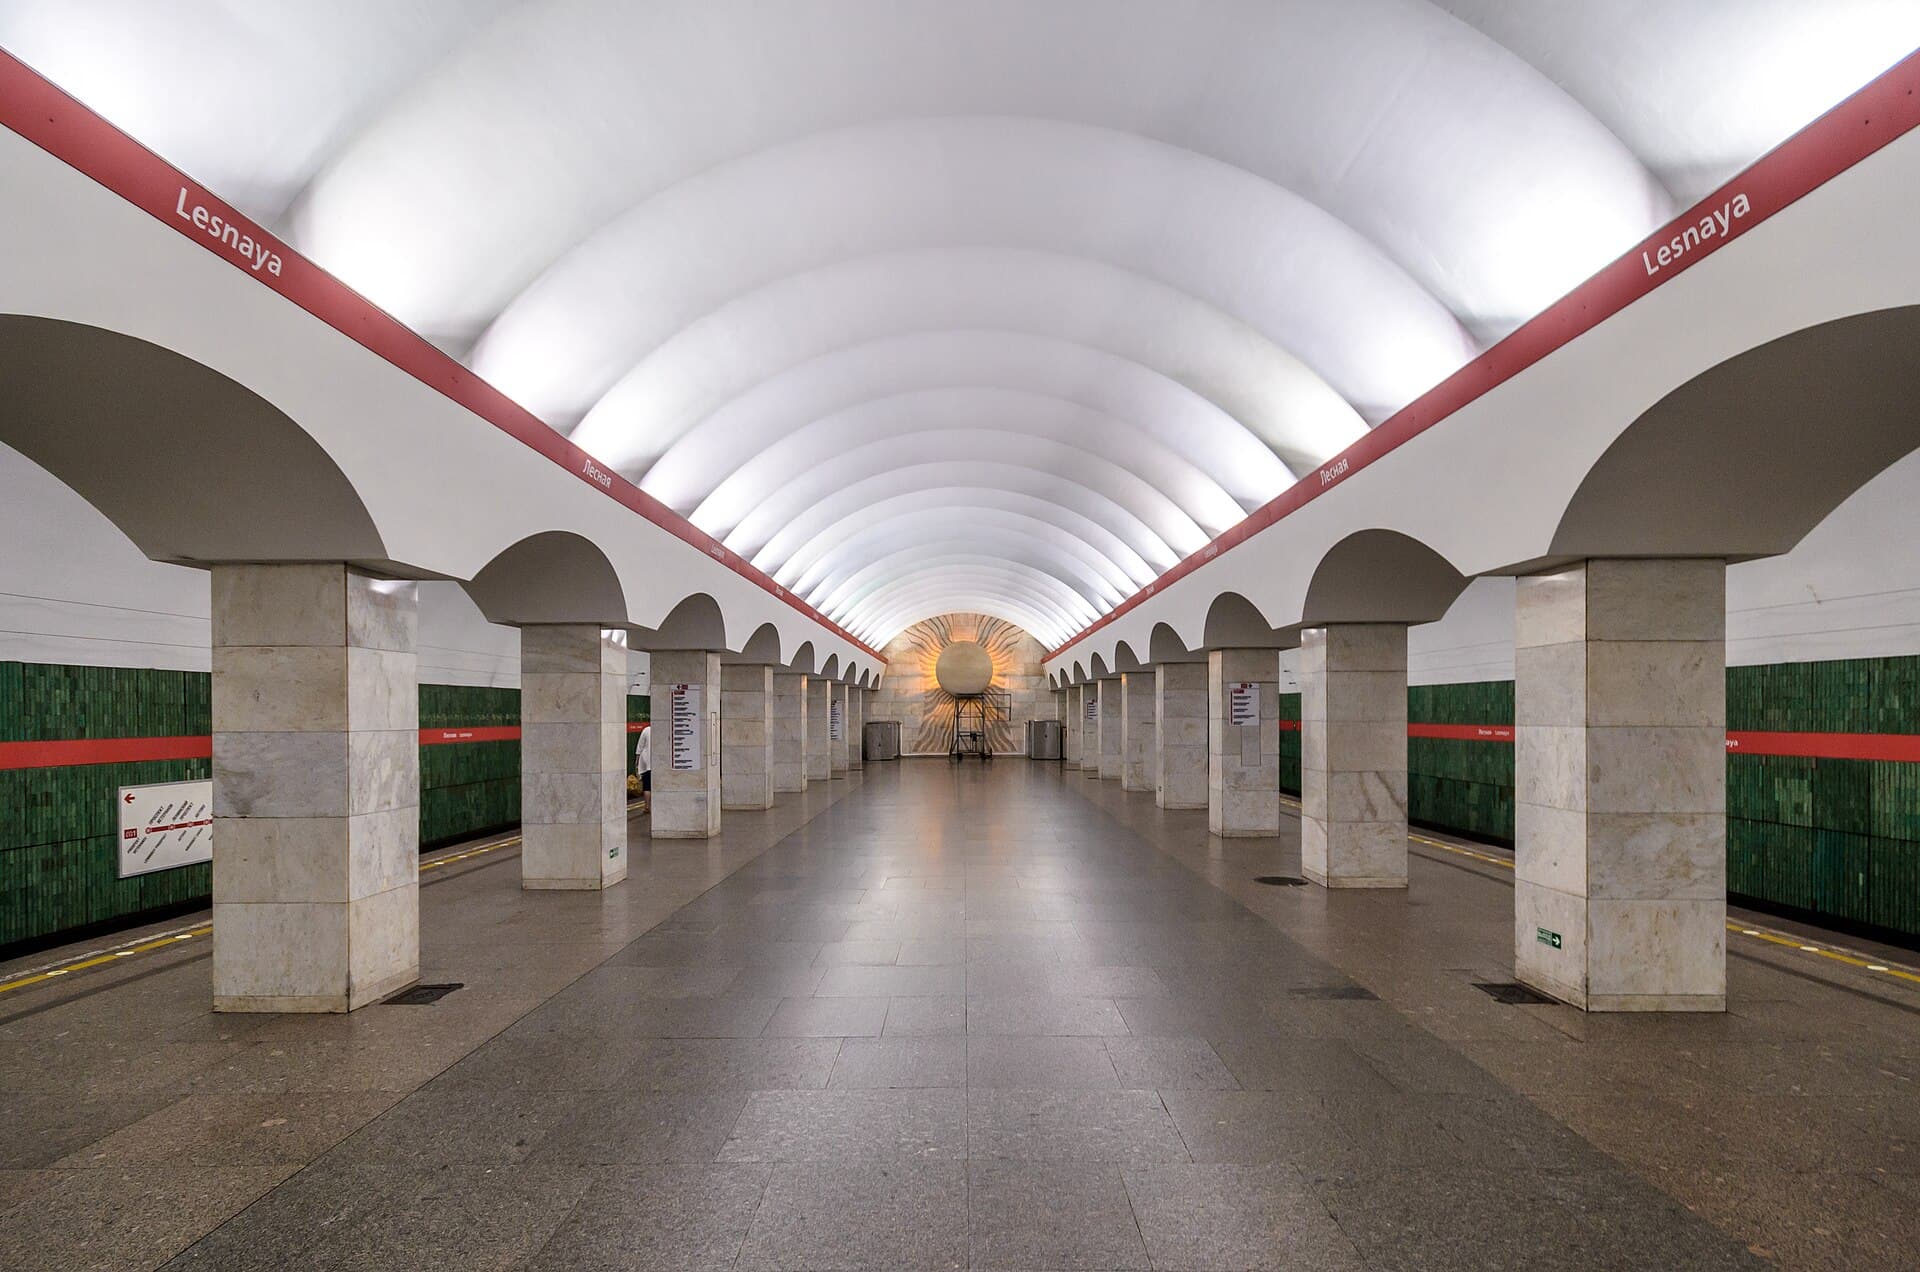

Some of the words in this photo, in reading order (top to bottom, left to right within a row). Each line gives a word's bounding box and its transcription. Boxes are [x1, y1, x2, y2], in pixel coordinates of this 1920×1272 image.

[176, 187, 282, 277] Lesnaya
[1642, 193, 1751, 276] Lesnaya
[582, 459, 612, 488] Лесная
[1320, 458, 1349, 486] Лесная
